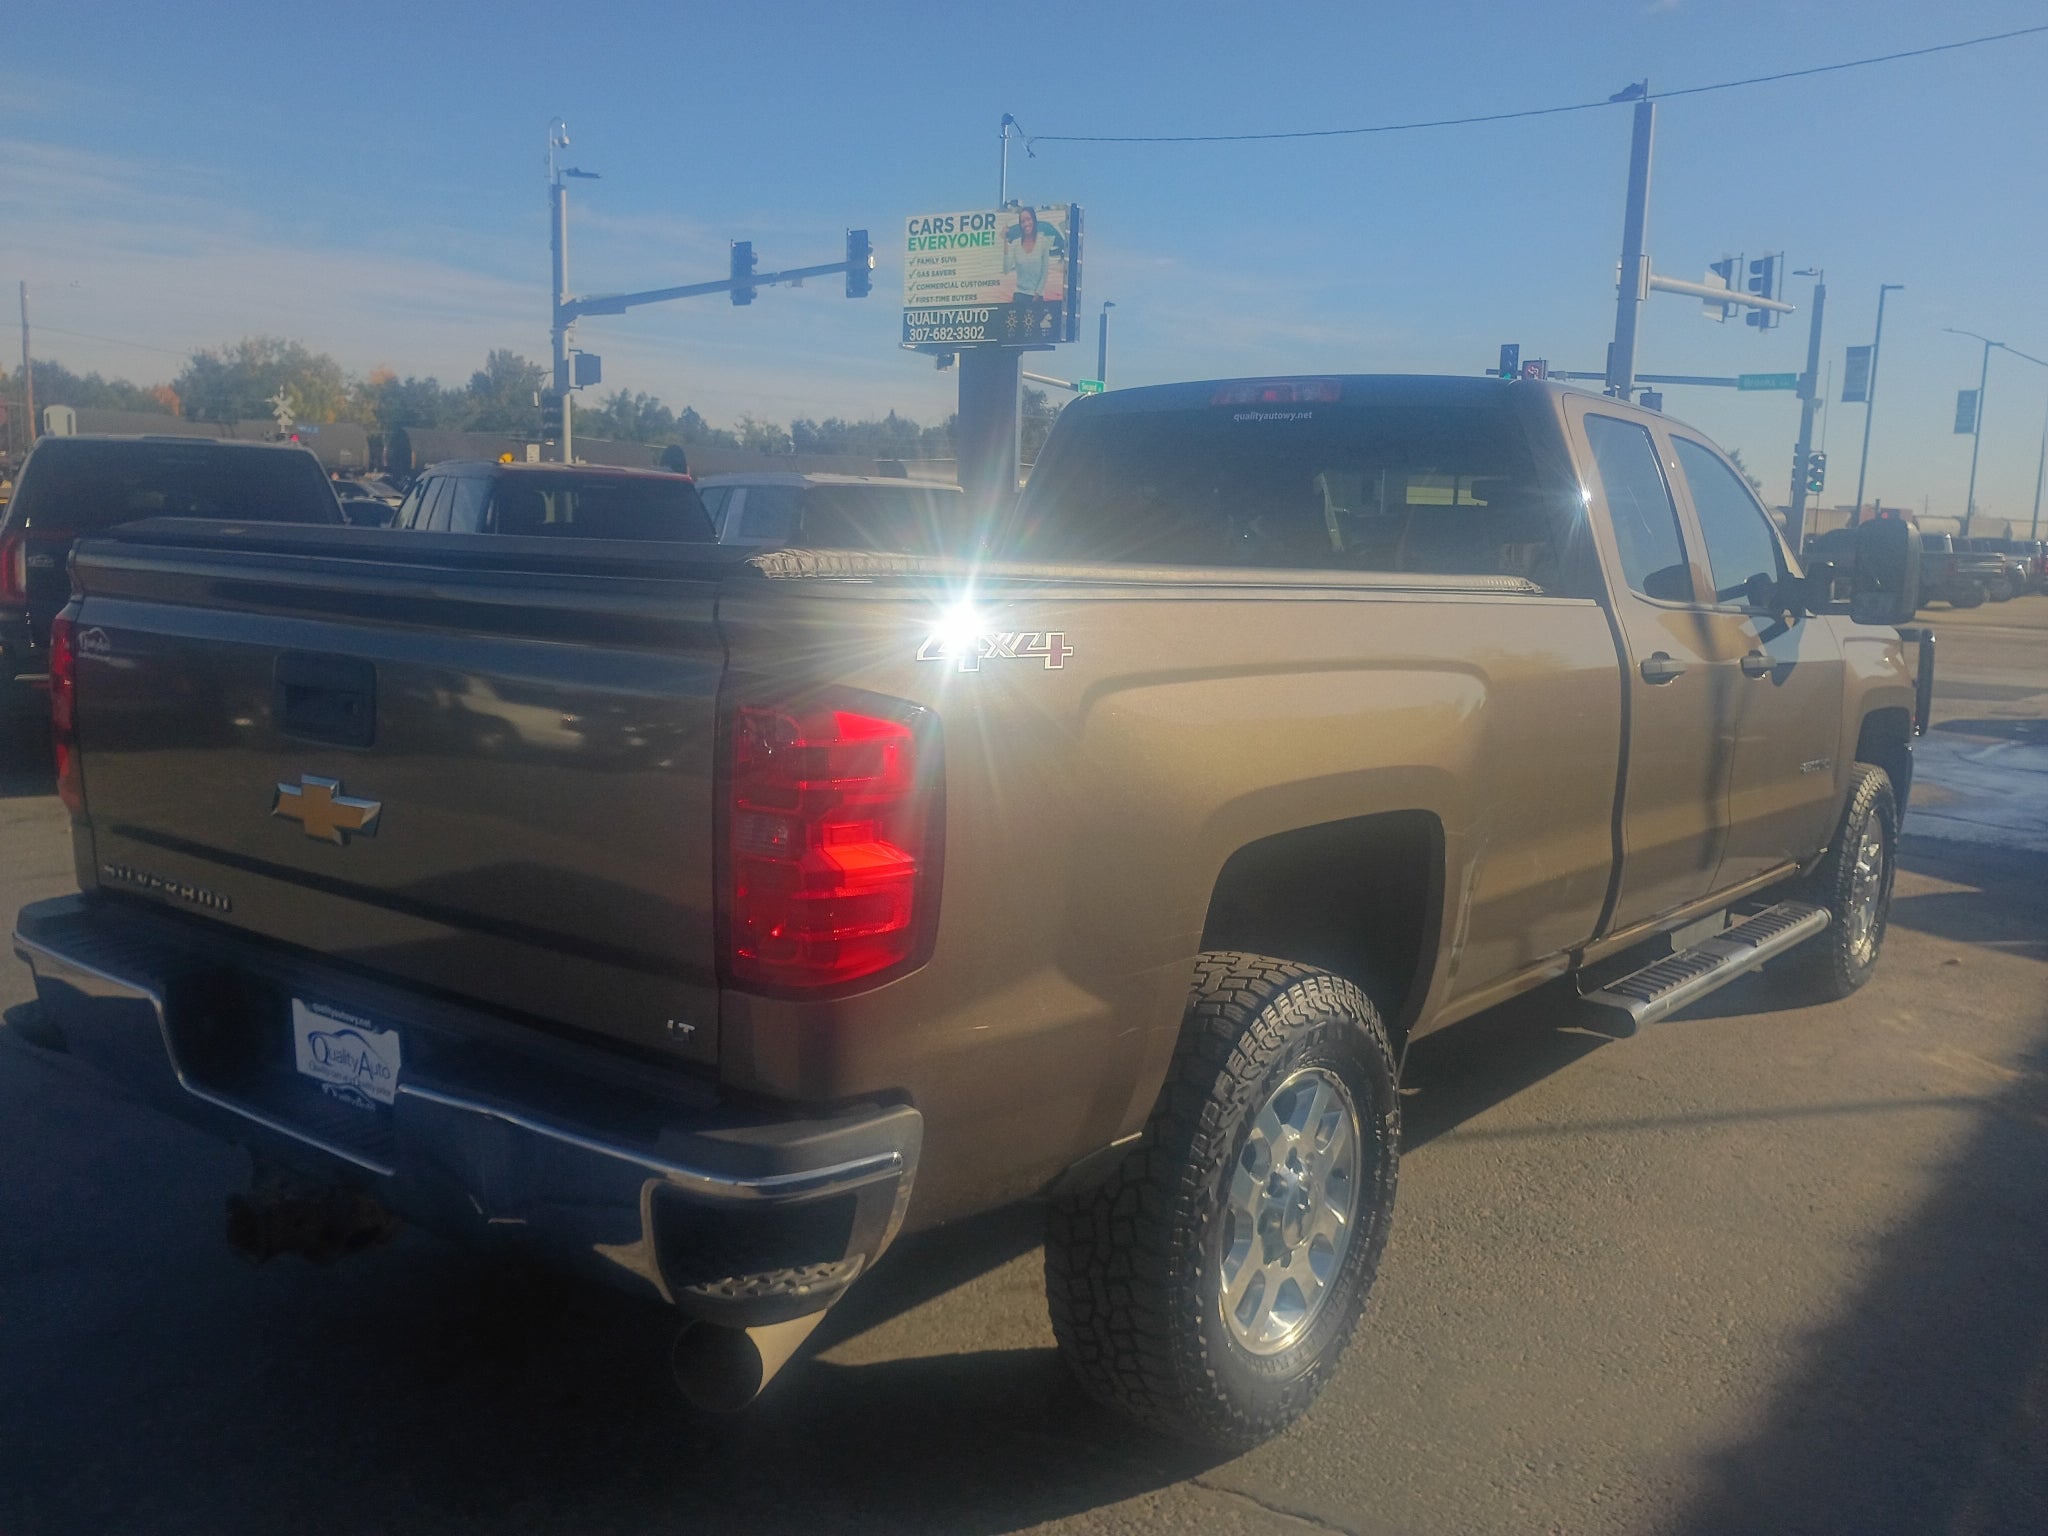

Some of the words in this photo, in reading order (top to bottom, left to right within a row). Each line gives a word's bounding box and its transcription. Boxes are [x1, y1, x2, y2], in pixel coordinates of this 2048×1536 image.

[908, 216, 954, 236] CARS
[960, 213, 996, 232] FOR
[907, 231, 996, 251] EVERYONE!
[916, 270, 930, 278] GAS
[931, 269, 957, 277] SAVERS
[915, 281, 959, 290] COMMERCIAL
[960, 279, 1001, 288] CUSTOMERS
[915, 295, 950, 303] FIRST-TIME
[952, 294, 978, 302] BUYERS
[906, 310, 955, 326] QUALITY
[955, 309, 989, 324] AUTO
[909, 326, 985, 341] 307-682-3302
[1233, 411, 1313, 422] qualityautowy.net
[312, 1036, 359, 1073] Quality
[358, 1051, 391, 1081] Auto
